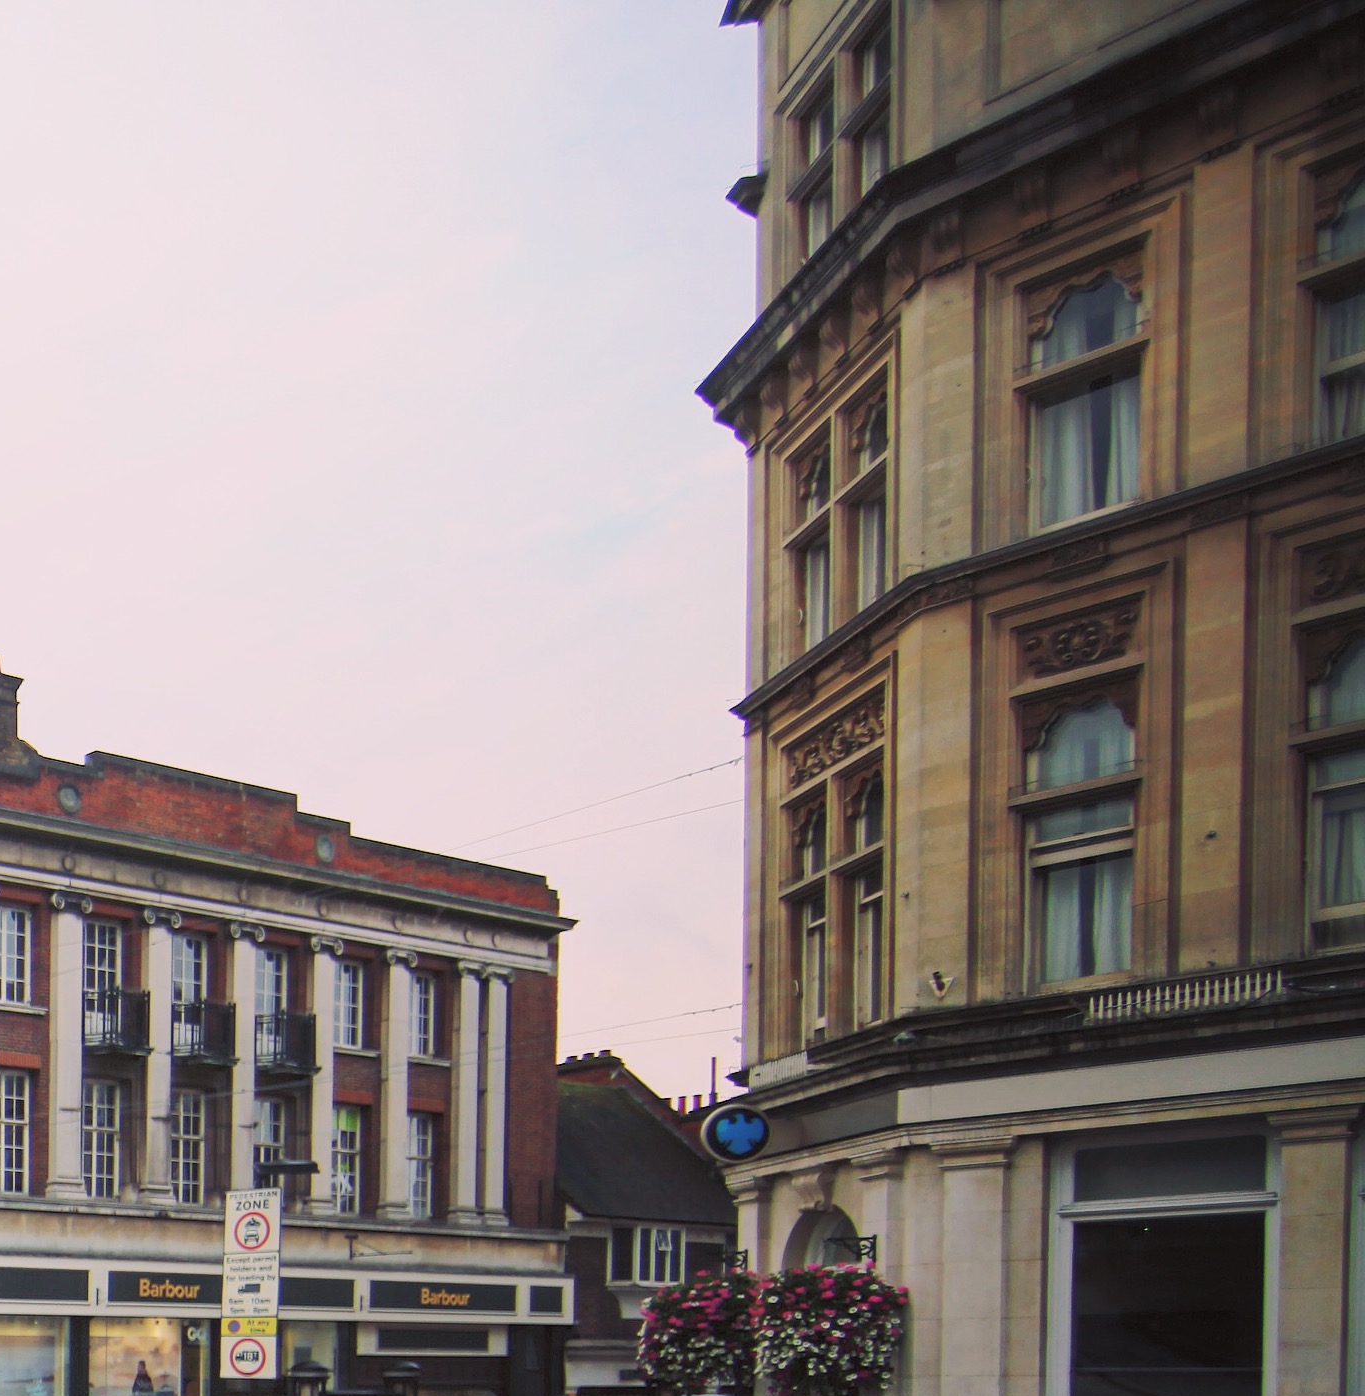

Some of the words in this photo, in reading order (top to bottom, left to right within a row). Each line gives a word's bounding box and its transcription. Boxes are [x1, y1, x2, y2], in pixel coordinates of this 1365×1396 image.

[230, 1191, 278, 1199] PEDESTRIAN
[236, 1200, 269, 1211] ZONE
[139, 1278, 201, 1298] Barbour
[421, 1287, 470, 1306] Barbour
